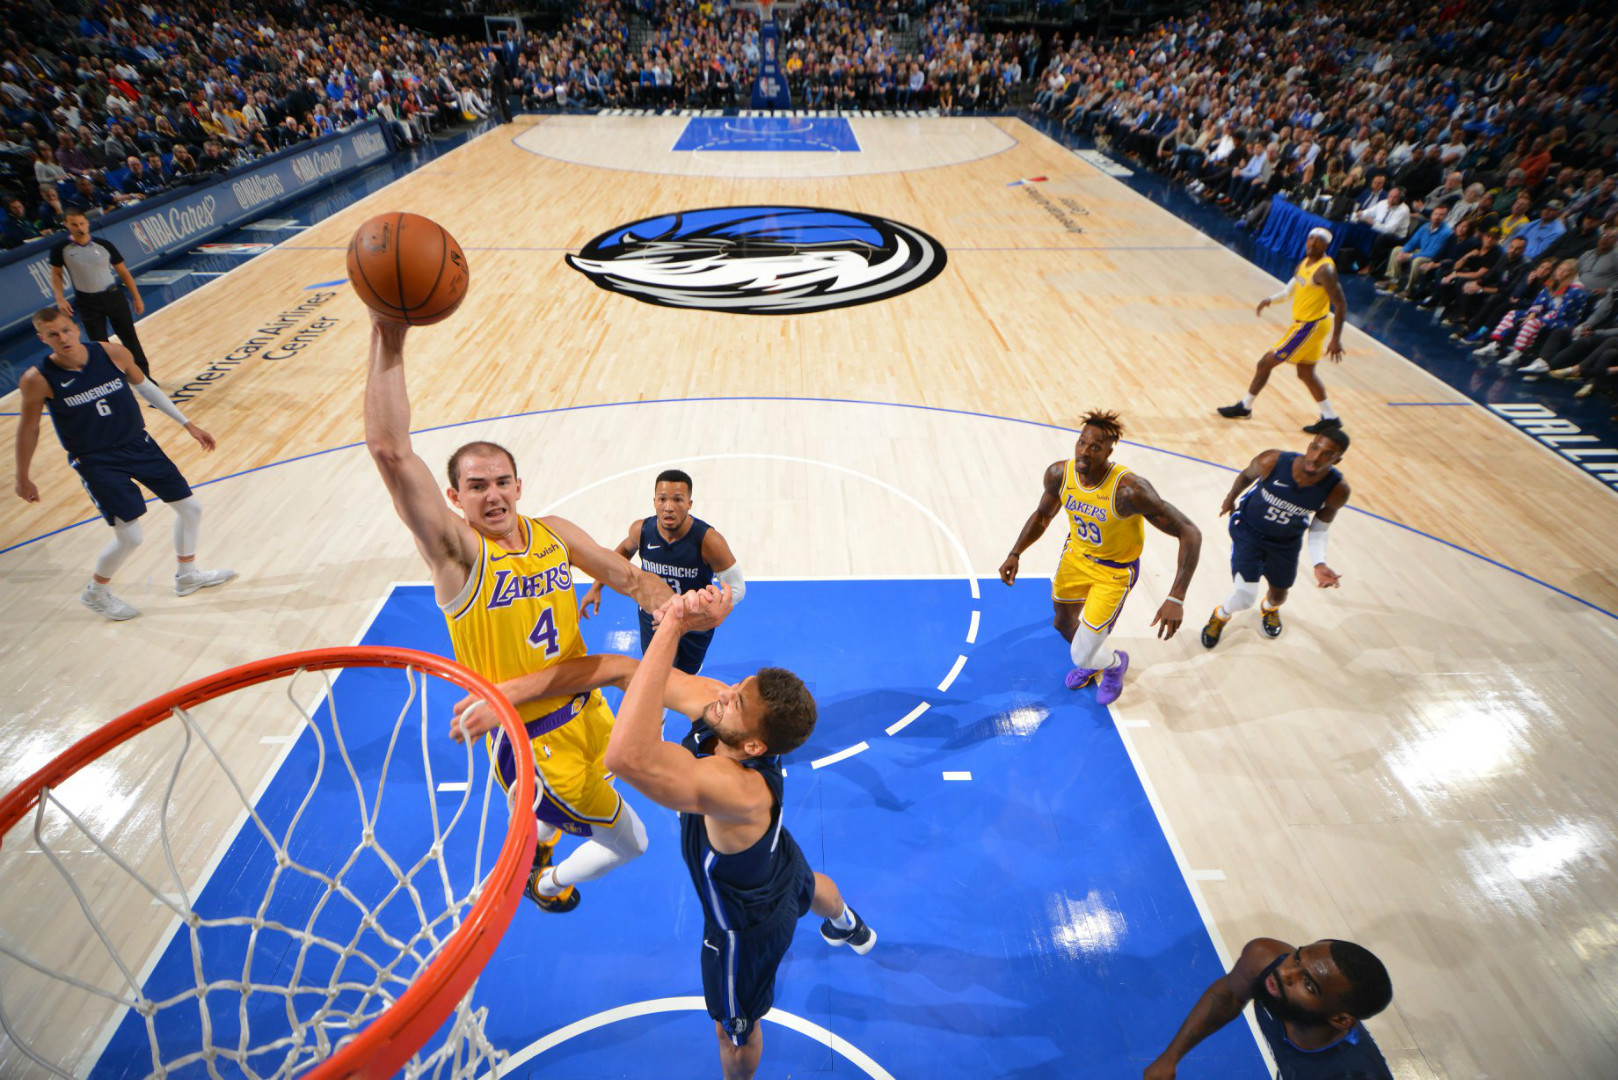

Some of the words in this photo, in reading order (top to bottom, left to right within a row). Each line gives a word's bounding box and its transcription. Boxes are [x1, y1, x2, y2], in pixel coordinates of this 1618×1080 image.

[297, 155, 318, 182] NBA
[313, 145, 342, 176] Cares
[232, 173, 284, 210] @NBACares
[140, 212, 177, 249] NBA
[169, 196, 215, 239] Cares
[148, 336, 275, 408] merican
[258, 291, 337, 336] Airlines
[262, 316, 340, 361] Center
[95, 398, 112, 417] 6
[1065, 494, 1107, 522] LAKERS
[1263, 506, 1293, 525] 55
[1073, 514, 1103, 546] 39
[533, 543, 560, 559] wish
[642, 558, 699, 579] MAVERICKS
[487, 562, 572, 611] LAKERS
[526, 605, 561, 662] 4
